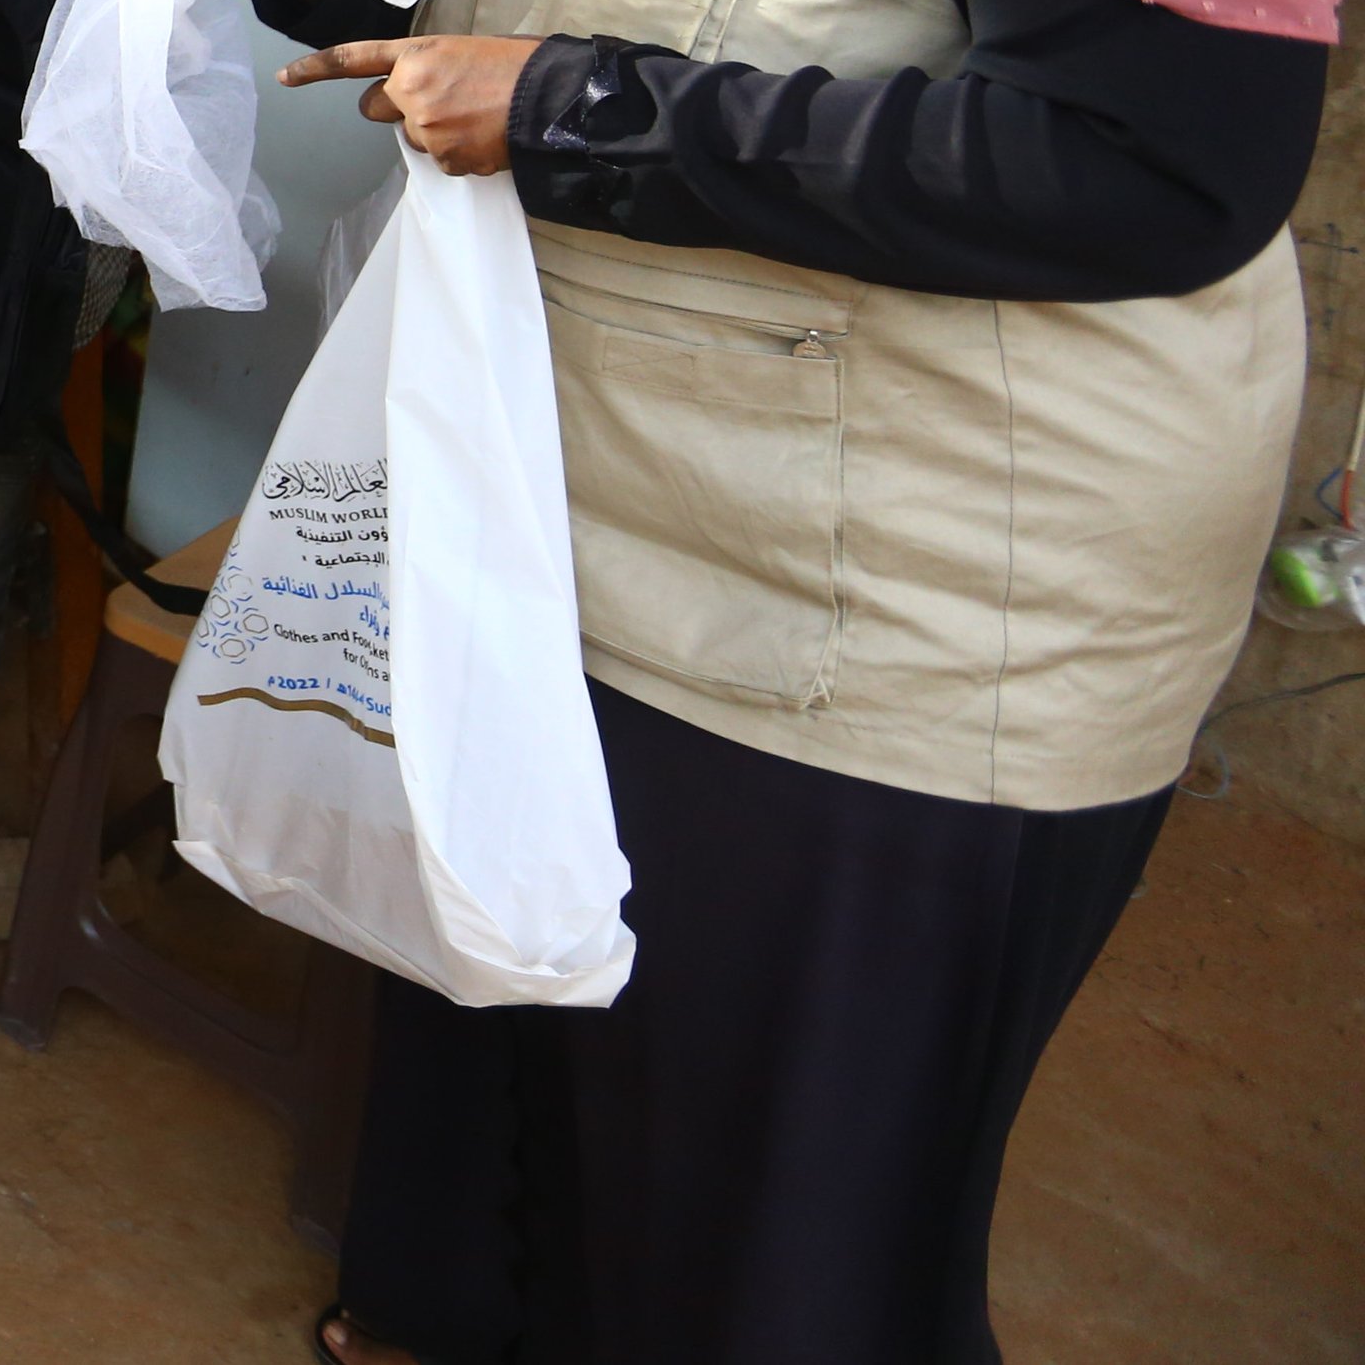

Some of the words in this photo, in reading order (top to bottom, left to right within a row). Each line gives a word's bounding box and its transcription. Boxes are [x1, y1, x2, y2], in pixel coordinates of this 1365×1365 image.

[269, 507, 329, 523] MUSLIM
[296, 526, 353, 545] التنفيذية
[262, 576, 318, 600] الغذائية
[322, 629, 350, 642] and
[343, 648, 359, 665] for
[277, 676, 320, 690] 2022
